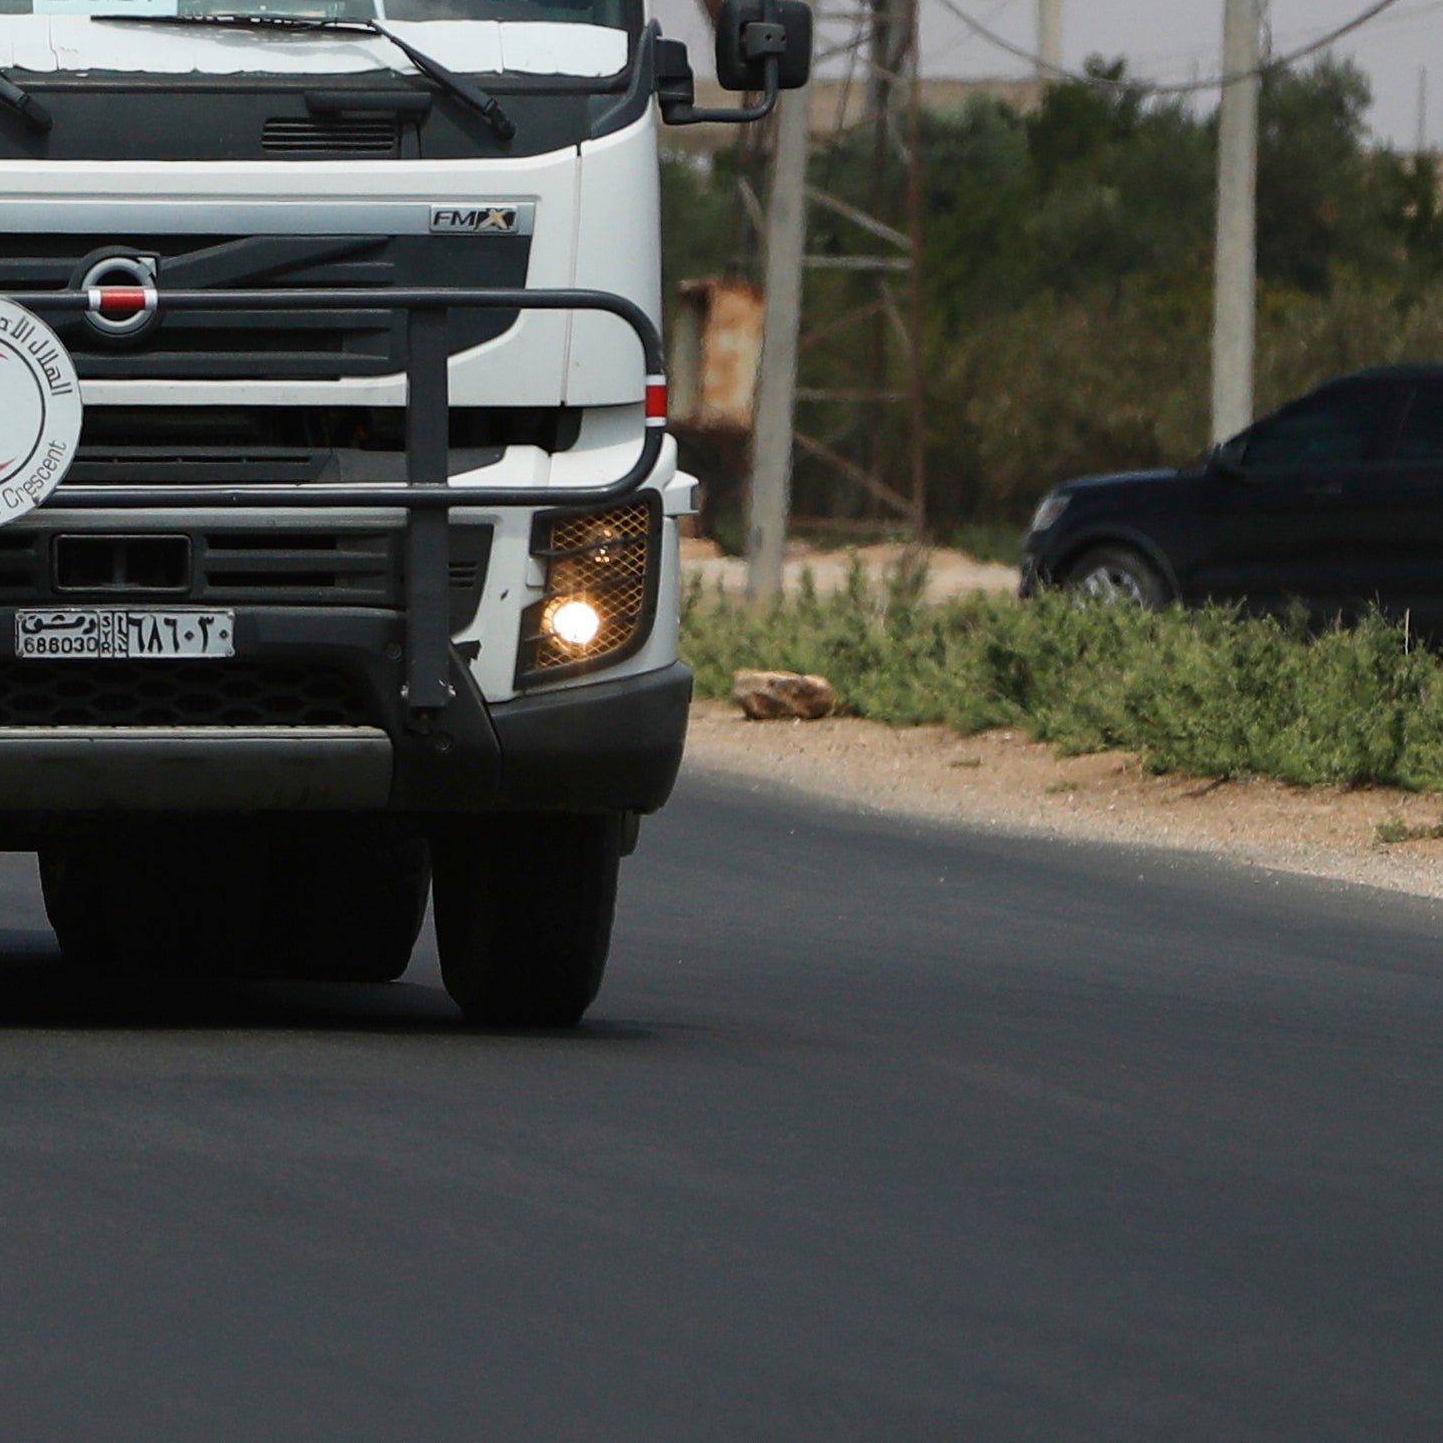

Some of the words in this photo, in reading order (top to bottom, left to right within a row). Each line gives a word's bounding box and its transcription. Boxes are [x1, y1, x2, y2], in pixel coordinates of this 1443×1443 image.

[433, 208, 517, 231] FMX
[25, 340, 73, 397] الهلال
[2, 439, 67, 508] Crescent
[127, 614, 229, 654] ٦٨٦٠٣٠
